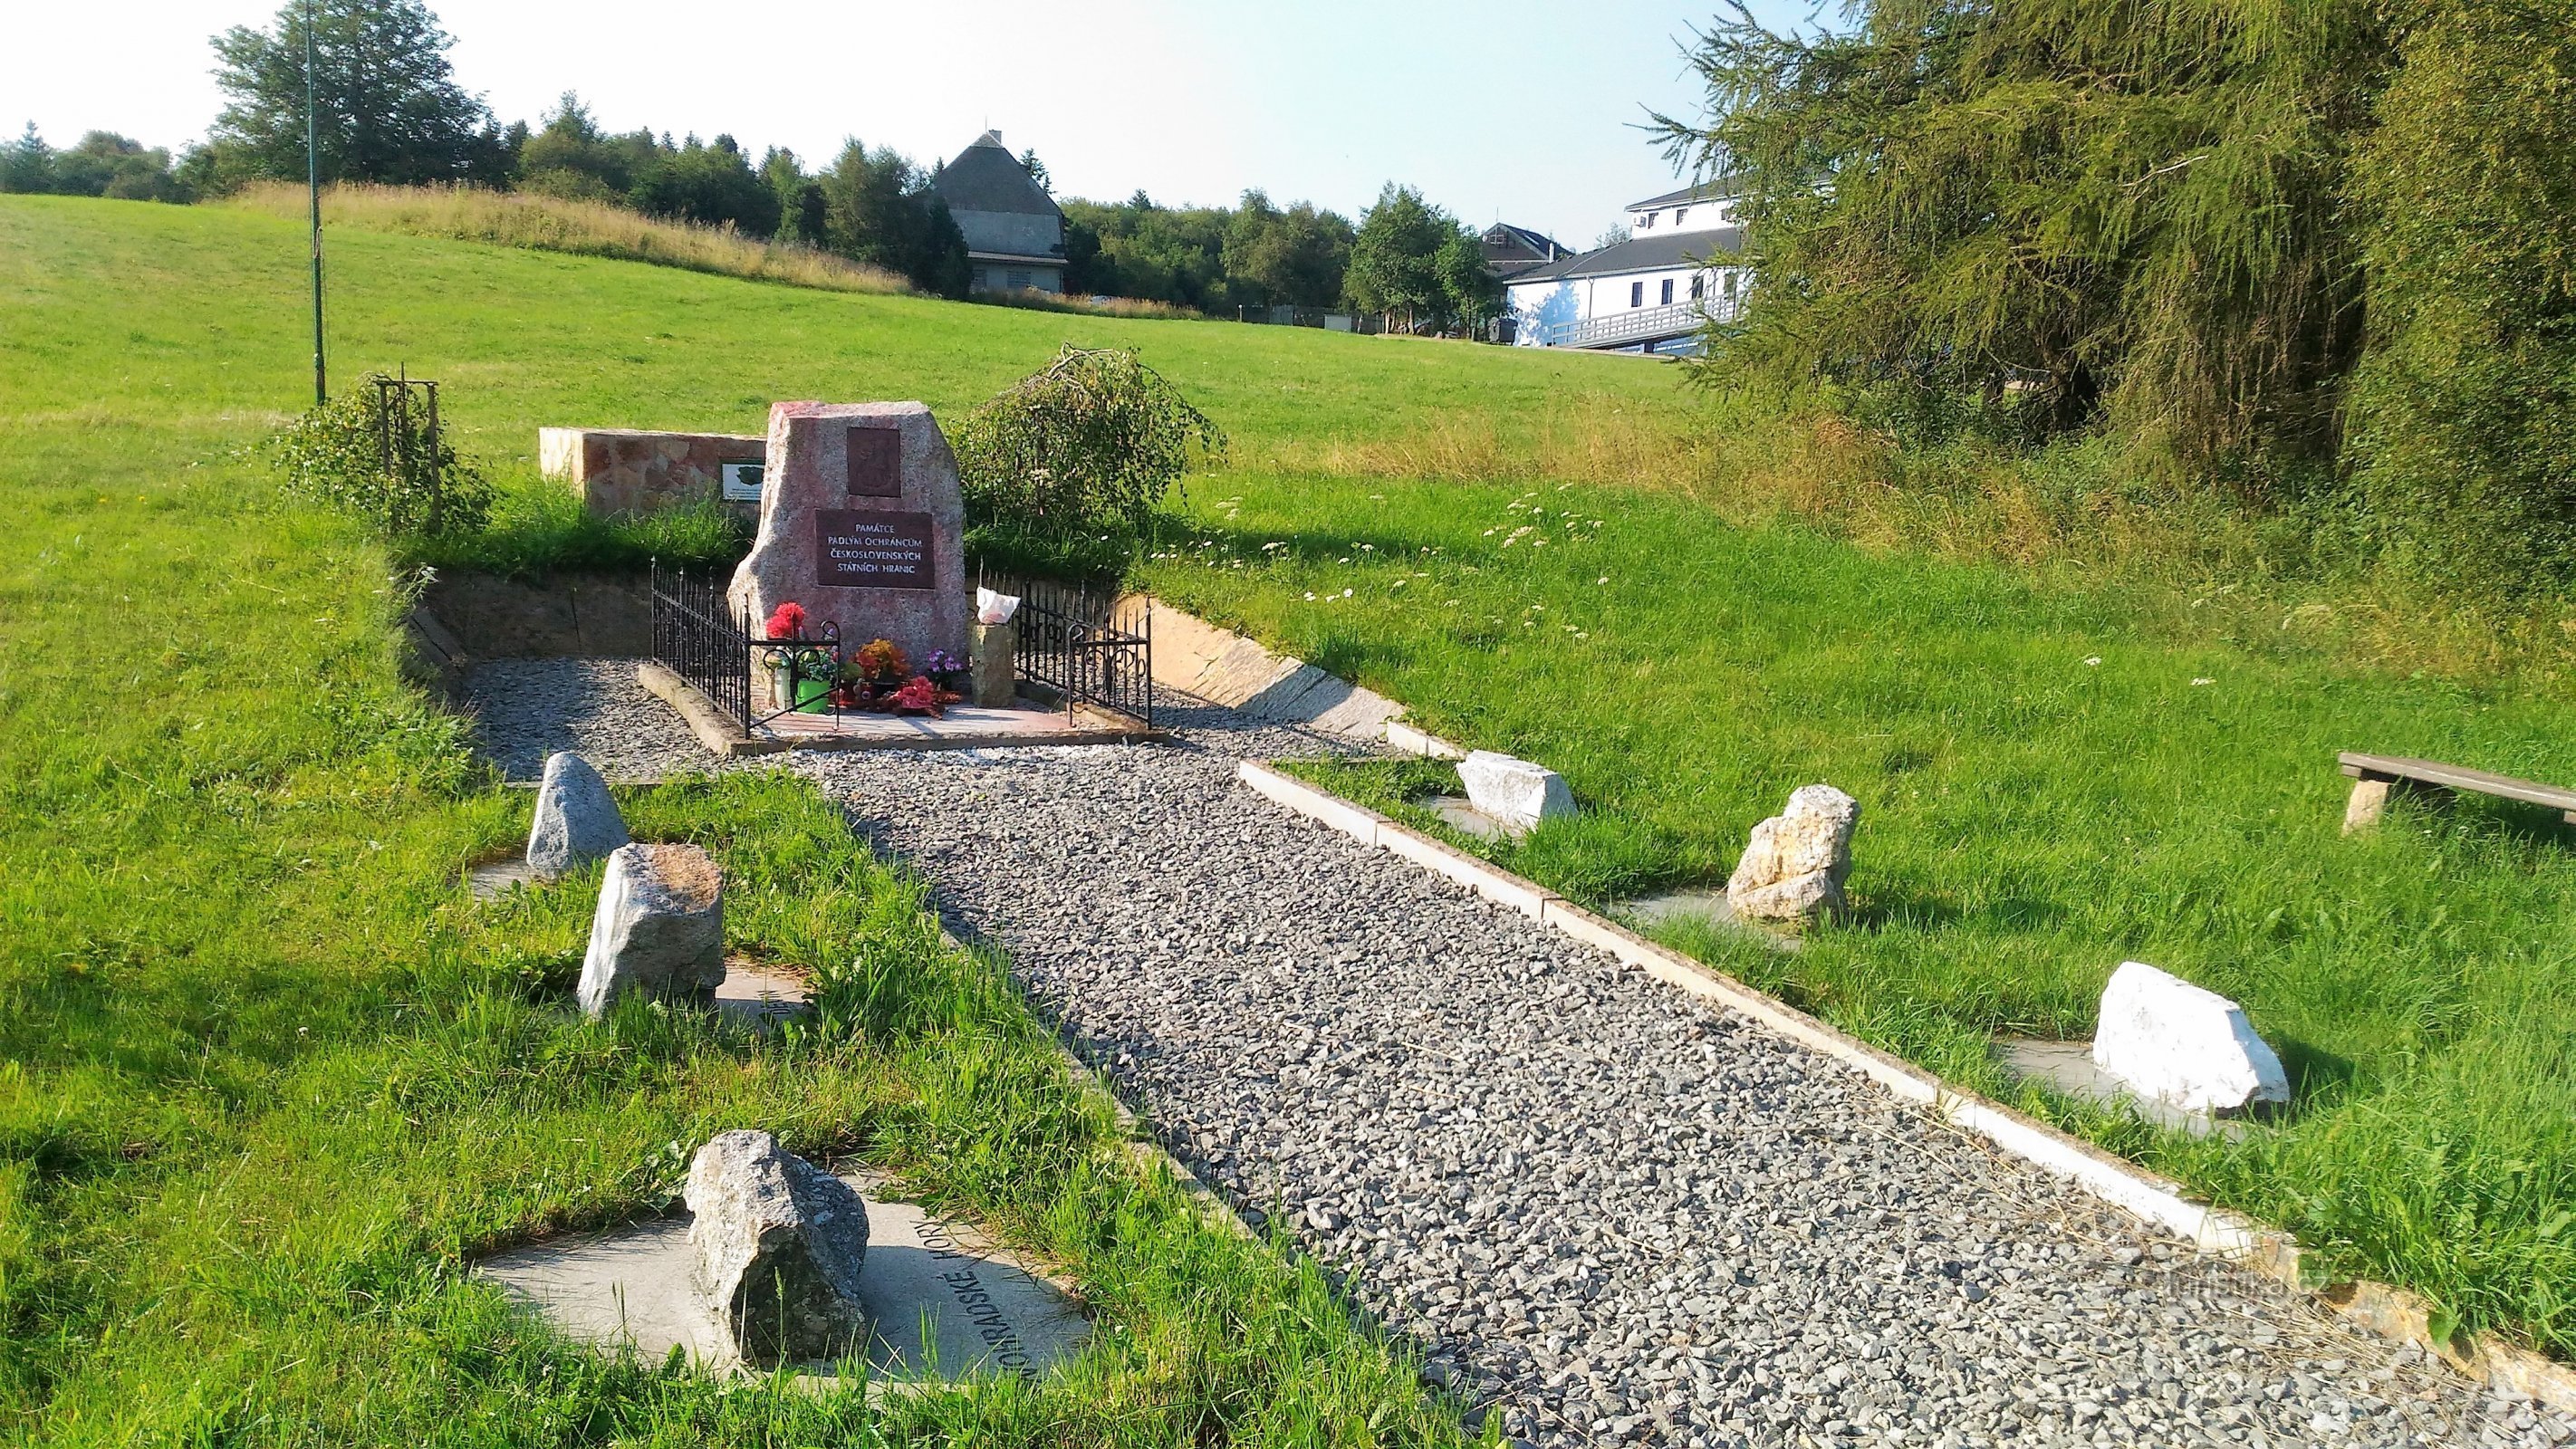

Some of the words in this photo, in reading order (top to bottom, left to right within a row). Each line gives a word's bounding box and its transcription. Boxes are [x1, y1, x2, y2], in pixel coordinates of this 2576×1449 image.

[855, 523, 895, 533] PAMÁTCE
[827, 535, 862, 545] PADLÝM
[830, 547, 921, 561] ČESKOSLOVENSKÝCH
[837, 561, 879, 572] STÁTNÍCH
[882, 564, 916, 574] HRANIC
[908, 1219, 963, 1260] HORY
